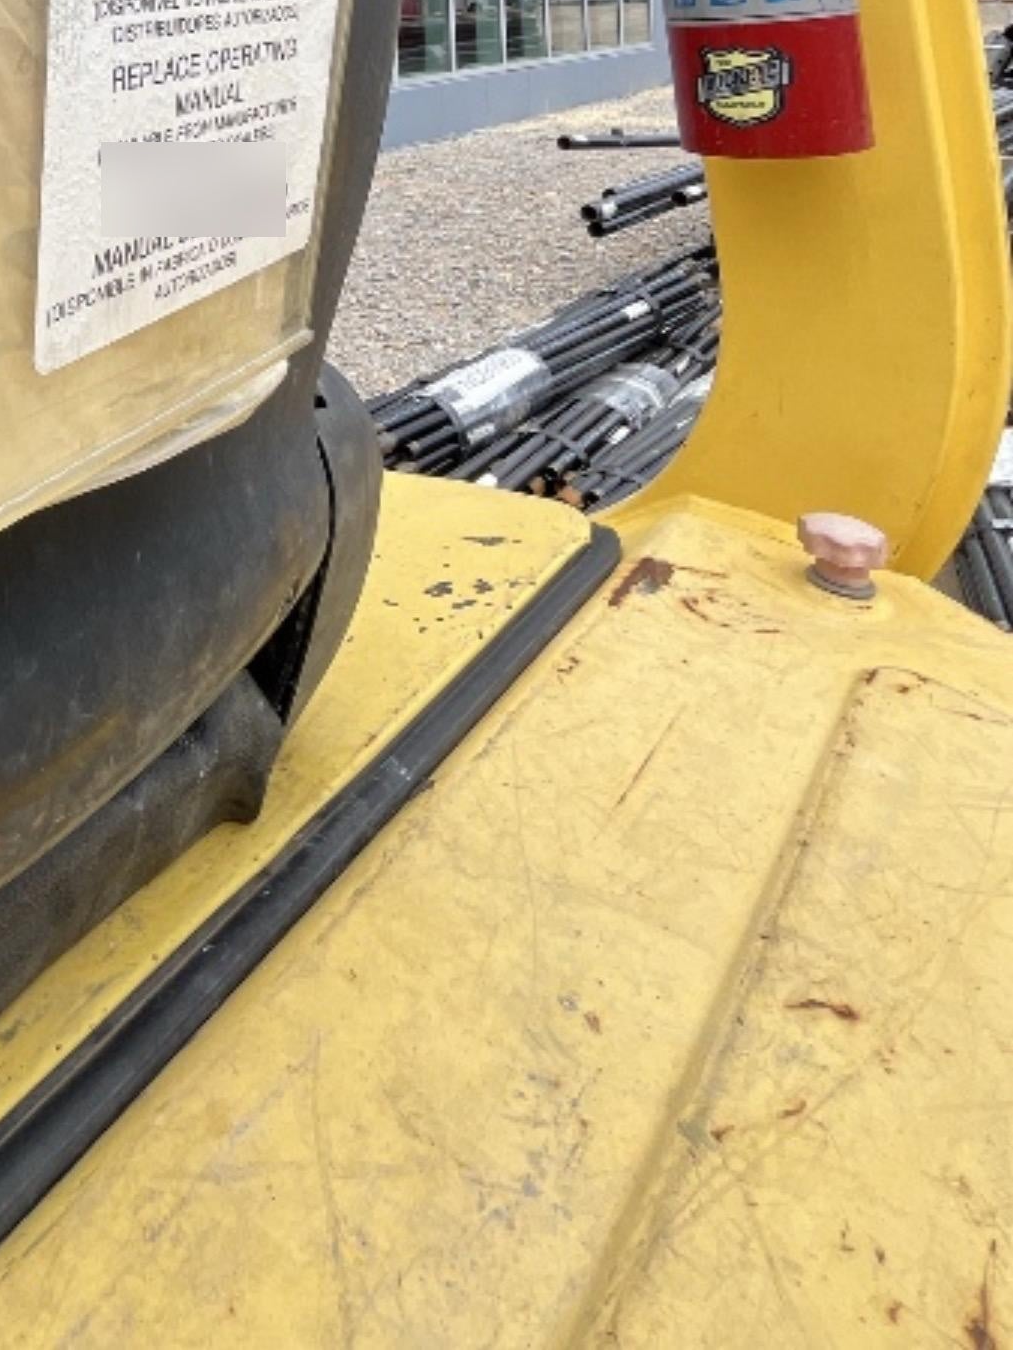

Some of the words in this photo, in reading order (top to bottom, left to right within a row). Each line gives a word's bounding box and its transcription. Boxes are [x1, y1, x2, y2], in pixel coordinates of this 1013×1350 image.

[112, 52, 202, 93] REPLACE
[206, 37, 298, 76] OPERATING
[175, 80, 245, 117] MANUAL
[91, 236, 174, 281] MANUAL
